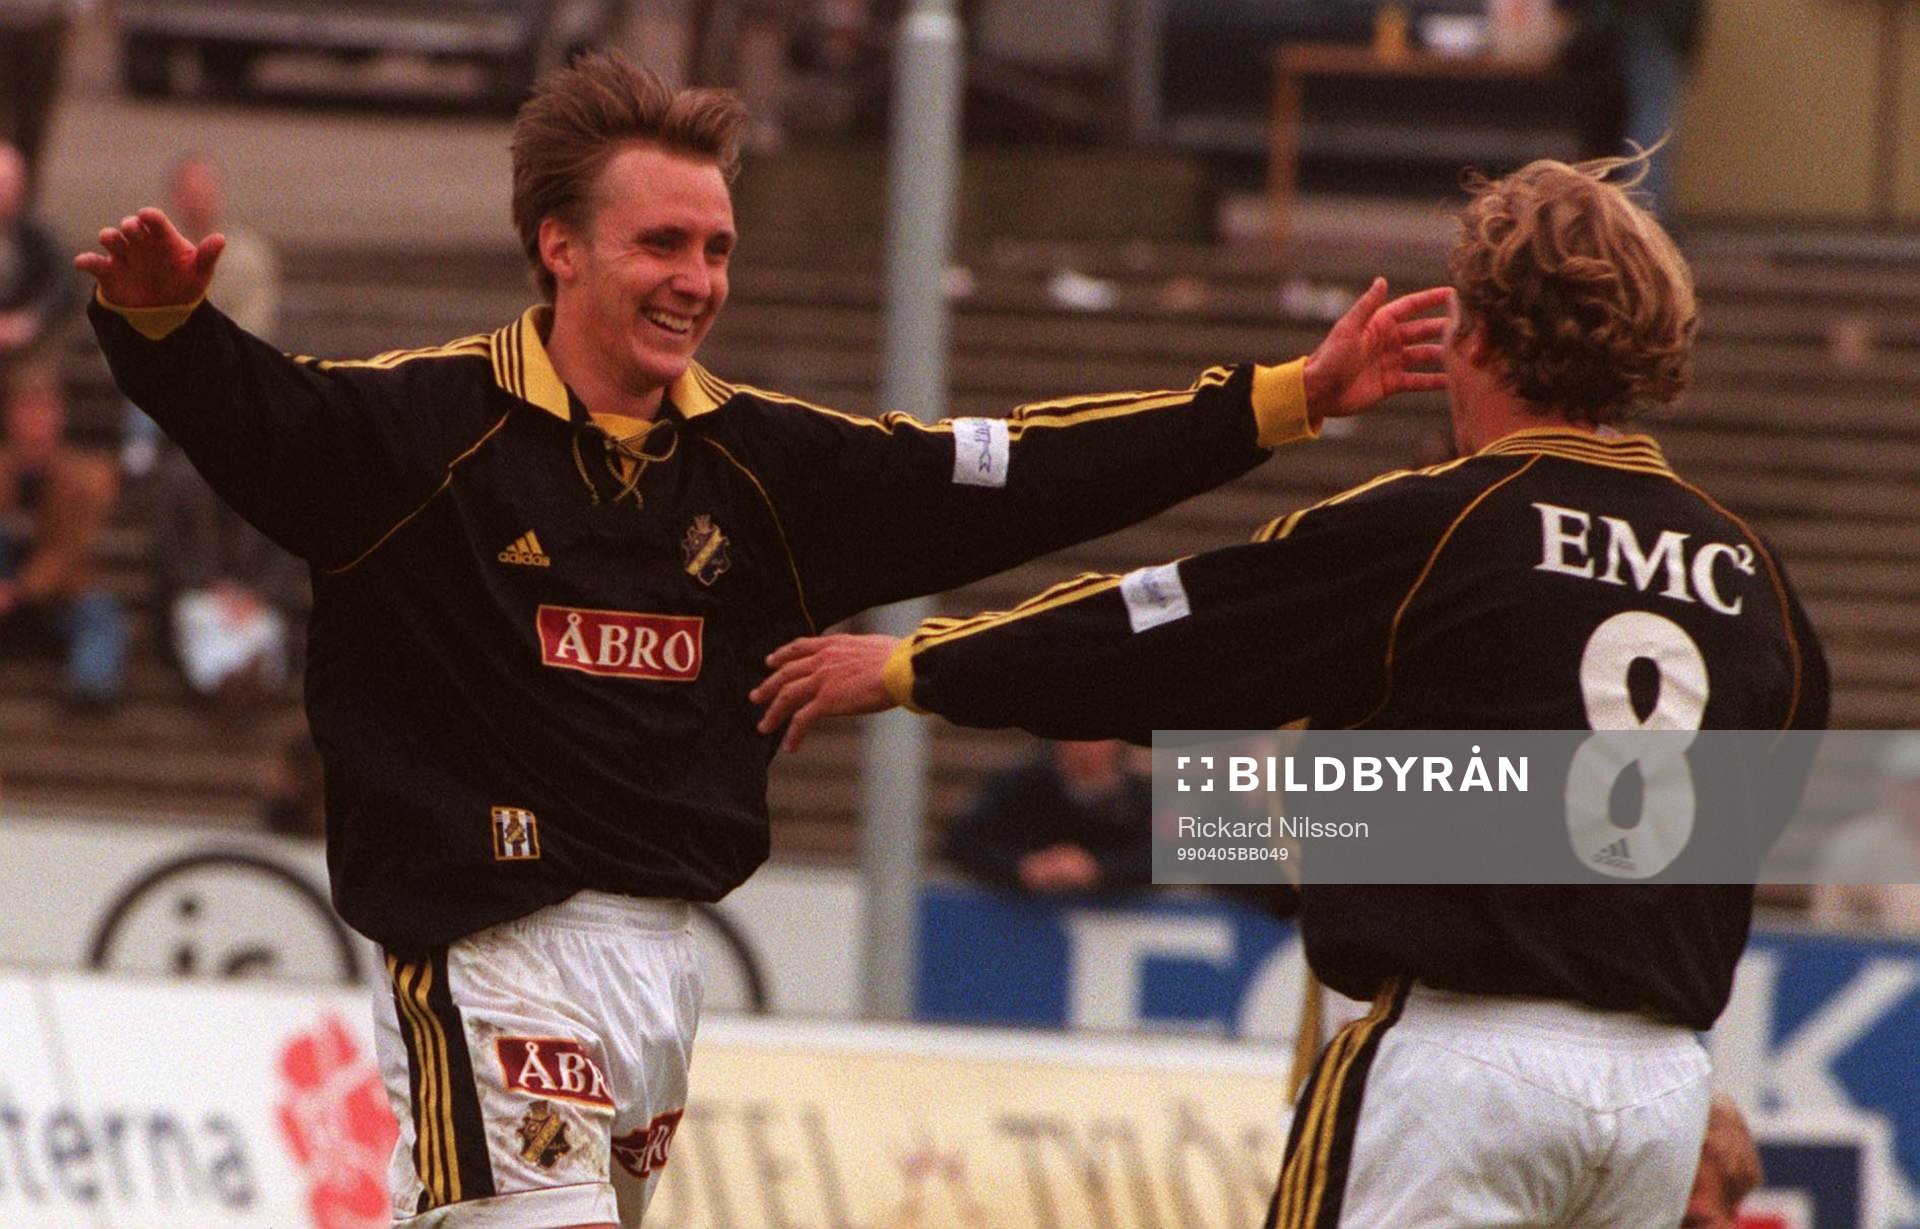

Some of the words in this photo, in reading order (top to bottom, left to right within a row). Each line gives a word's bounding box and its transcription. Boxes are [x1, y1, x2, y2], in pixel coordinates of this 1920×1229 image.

[498, 551, 551, 568] adidas
[555, 612, 697, 673] ÅBRO
[1565, 610, 1711, 880] 8
[517, 1041, 613, 1099] ÅBR
